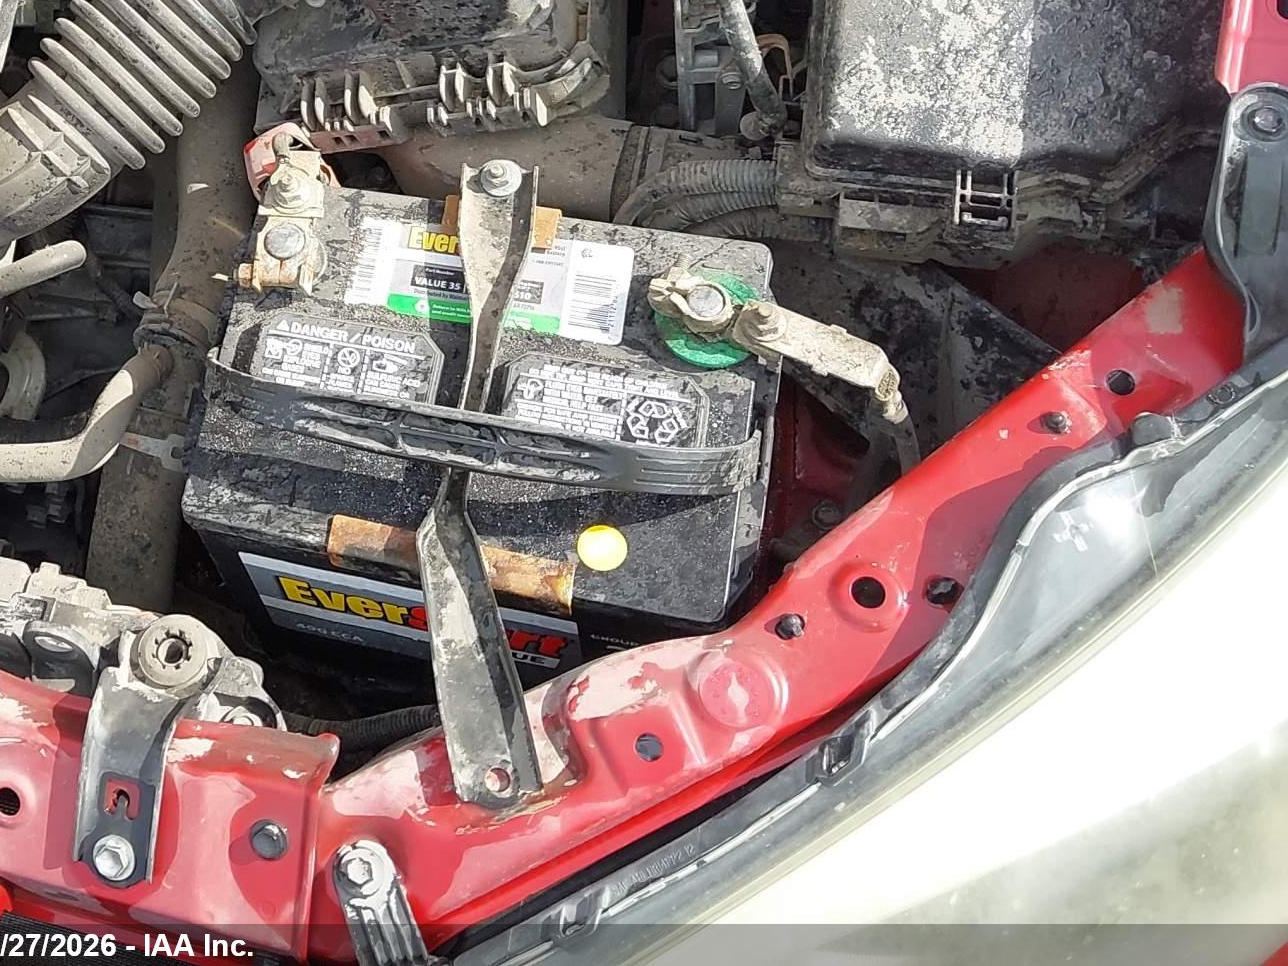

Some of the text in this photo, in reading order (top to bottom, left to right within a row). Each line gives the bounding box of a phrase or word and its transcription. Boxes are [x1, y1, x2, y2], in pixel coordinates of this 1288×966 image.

[414, 276, 461, 291] VALUE 35
[290, 321, 349, 341] DANGER
[361, 334, 416, 354] POISON
